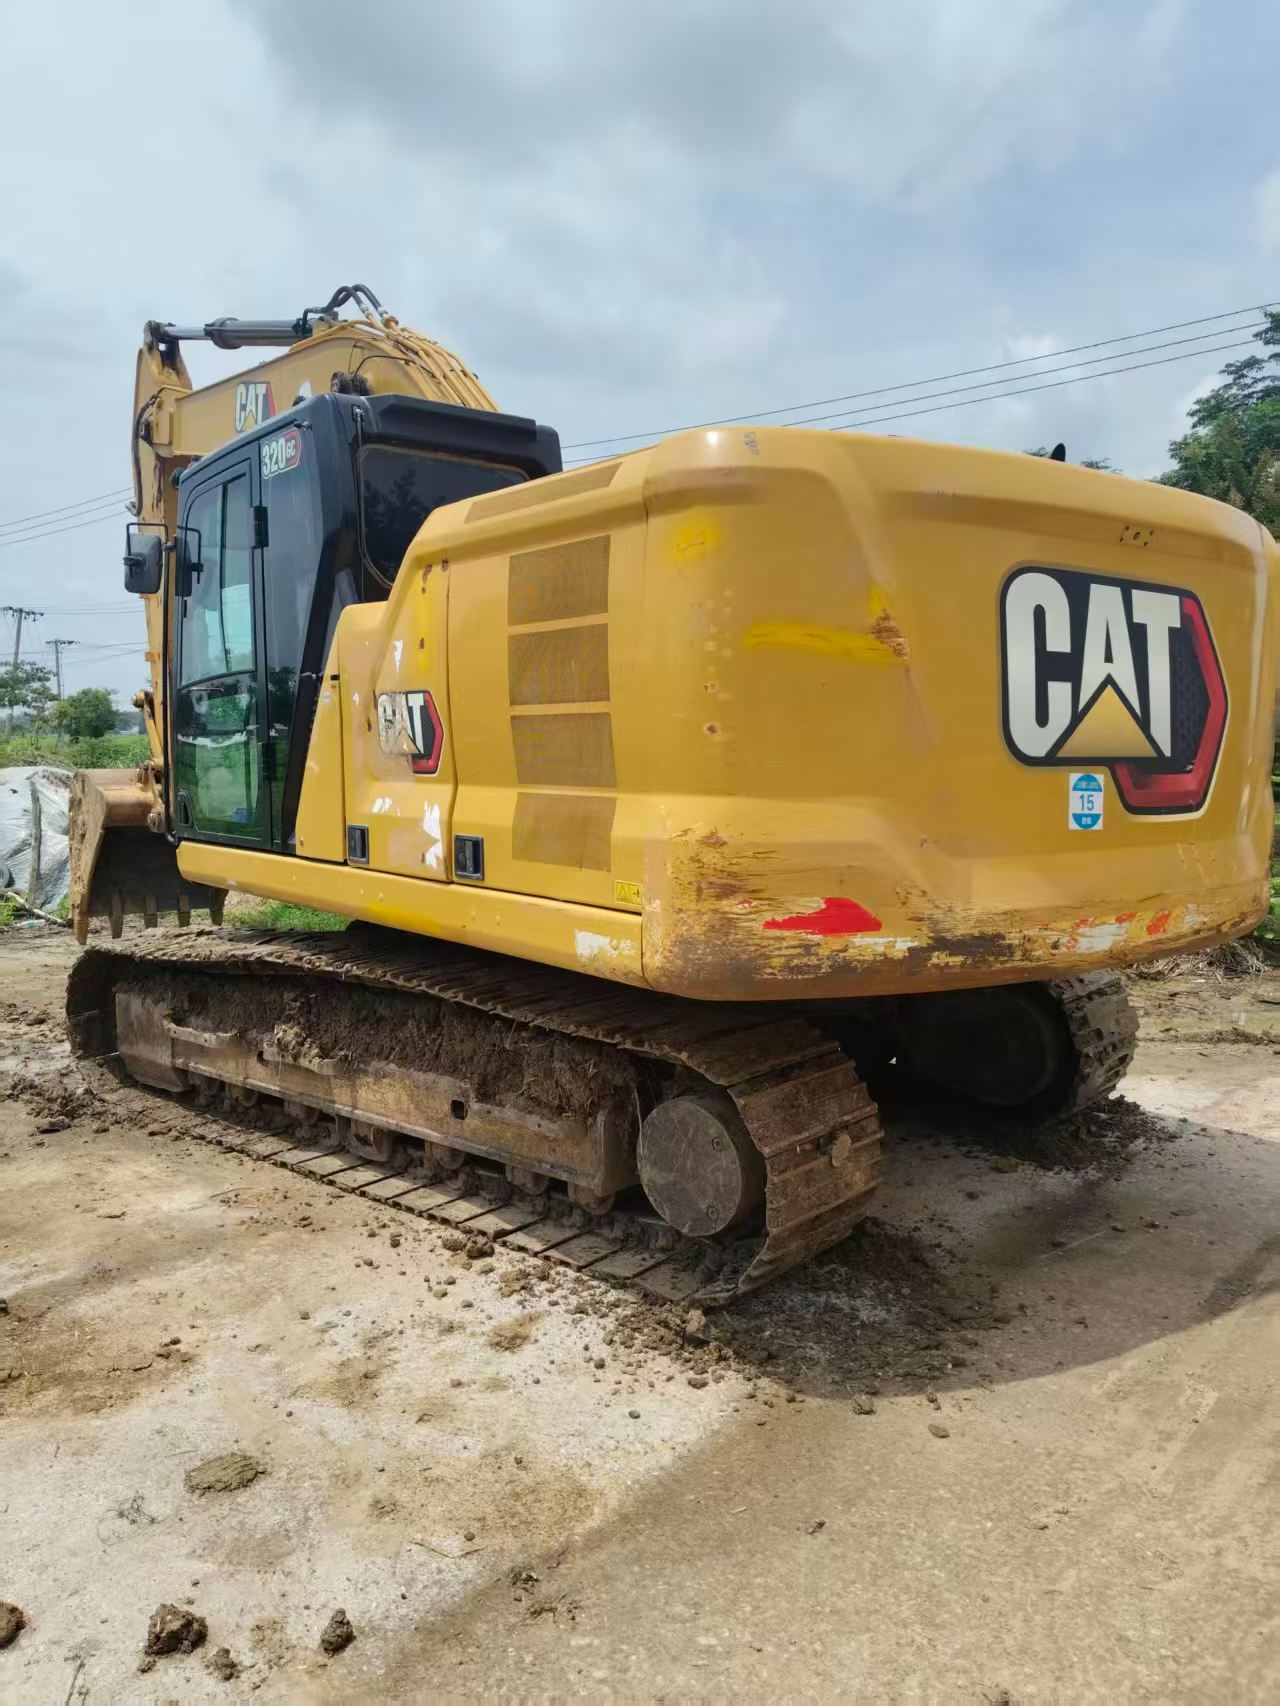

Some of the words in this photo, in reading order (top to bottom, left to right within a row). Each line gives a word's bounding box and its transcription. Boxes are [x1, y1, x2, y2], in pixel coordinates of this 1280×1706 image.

[235, 383, 267, 433] CAT
[262, 437, 286, 476] 320
[1005, 572, 1181, 758] CAT
[377, 692, 424, 755] CAT
[1079, 793, 1095, 812] 15
